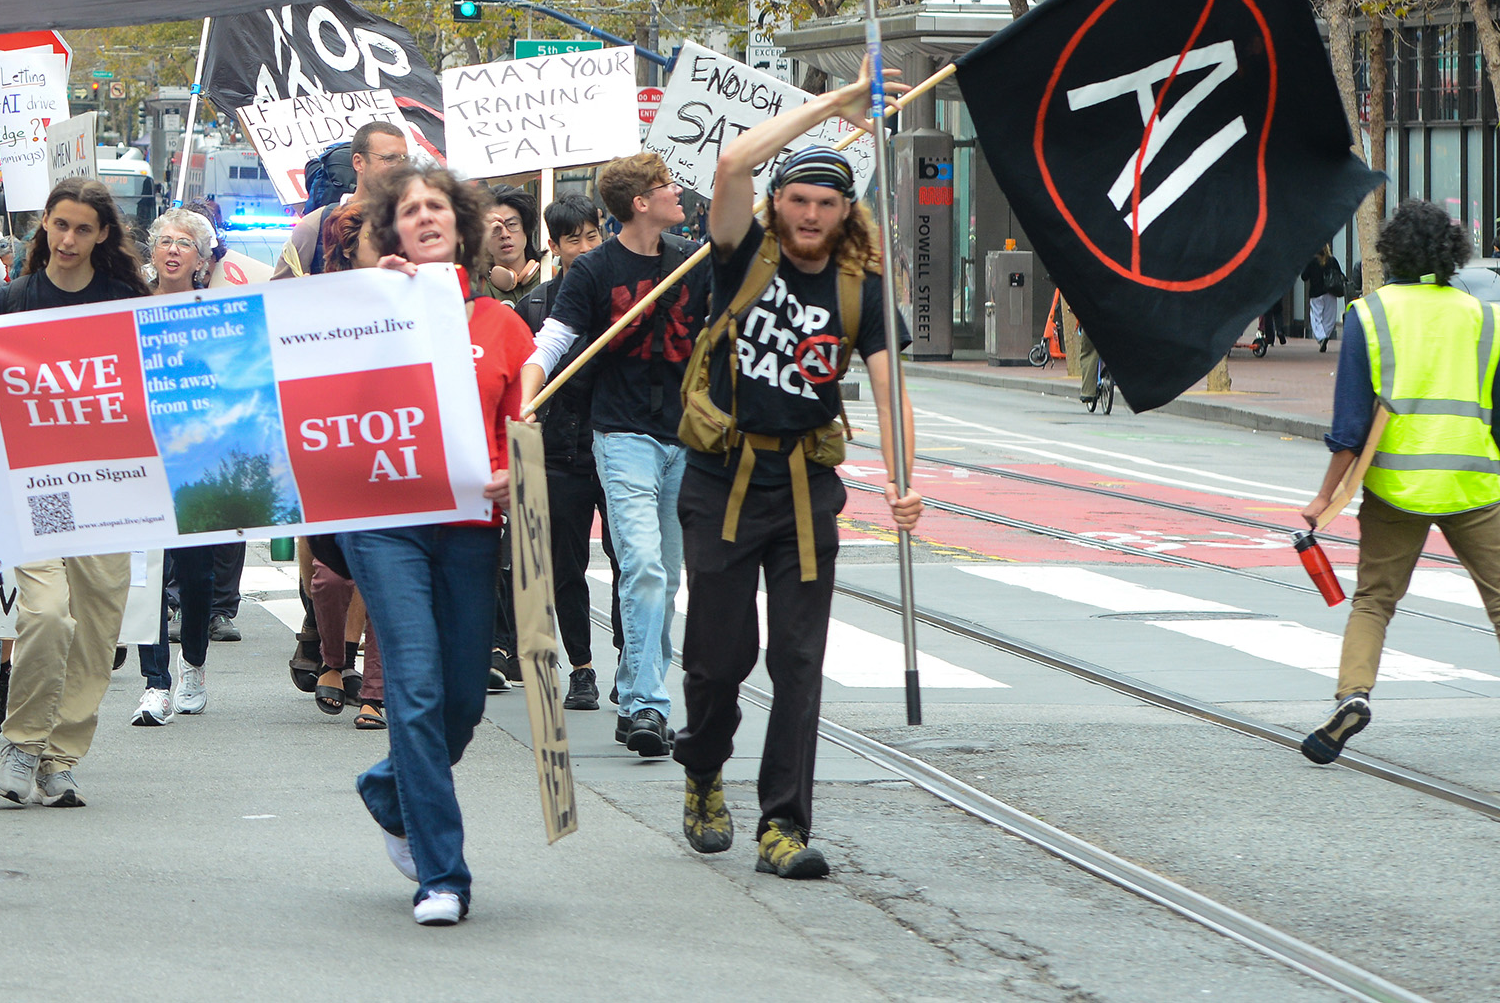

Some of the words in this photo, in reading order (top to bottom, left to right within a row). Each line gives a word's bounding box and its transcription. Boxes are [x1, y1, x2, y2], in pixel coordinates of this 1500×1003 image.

[537, 44, 558, 56] 5th
[566, 44, 581, 54] St
[1, 66, 46, 87] Letting
[456, 58, 550, 90] MAY
[561, 52, 632, 79] YOUR
[691, 55, 782, 117] ENOUGH
[27, 94, 57, 111] drive
[242, 105, 269, 126] IF
[293, 90, 391, 119] ANYONE
[448, 84, 607, 121] TRAINING
[257, 115, 359, 152] BUILDS
[468, 114, 566, 138] RUNS
[1067, 39, 1247, 237] AI
[50, 140, 71, 170] WHEN
[76, 133, 86, 161] AI
[485, 134, 593, 164] FAIL
[679, 158, 694, 170] we
[918, 215, 930, 279] POWELL
[138, 302, 221, 325] Billionares
[223, 300, 248, 313] are
[918, 285, 930, 342] STREET
[141, 330, 189, 350] trying
[191, 328, 208, 341] to
[211, 322, 245, 338] take
[280, 318, 415, 346] www.stopai.live
[2, 354, 122, 396] SAVE
[144, 353, 164, 371] all
[167, 350, 185, 368] of
[147, 376, 177, 393] this
[180, 374, 218, 390] away
[23, 392, 129, 427] LIFE
[150, 398, 189, 416] from
[300, 407, 425, 451] STOP
[26, 474, 63, 489] Join
[67, 471, 92, 484] On
[95, 465, 147, 482] Signal
[368, 445, 422, 483] AI
[78, 514, 165, 530] www.stopai.live/signal
